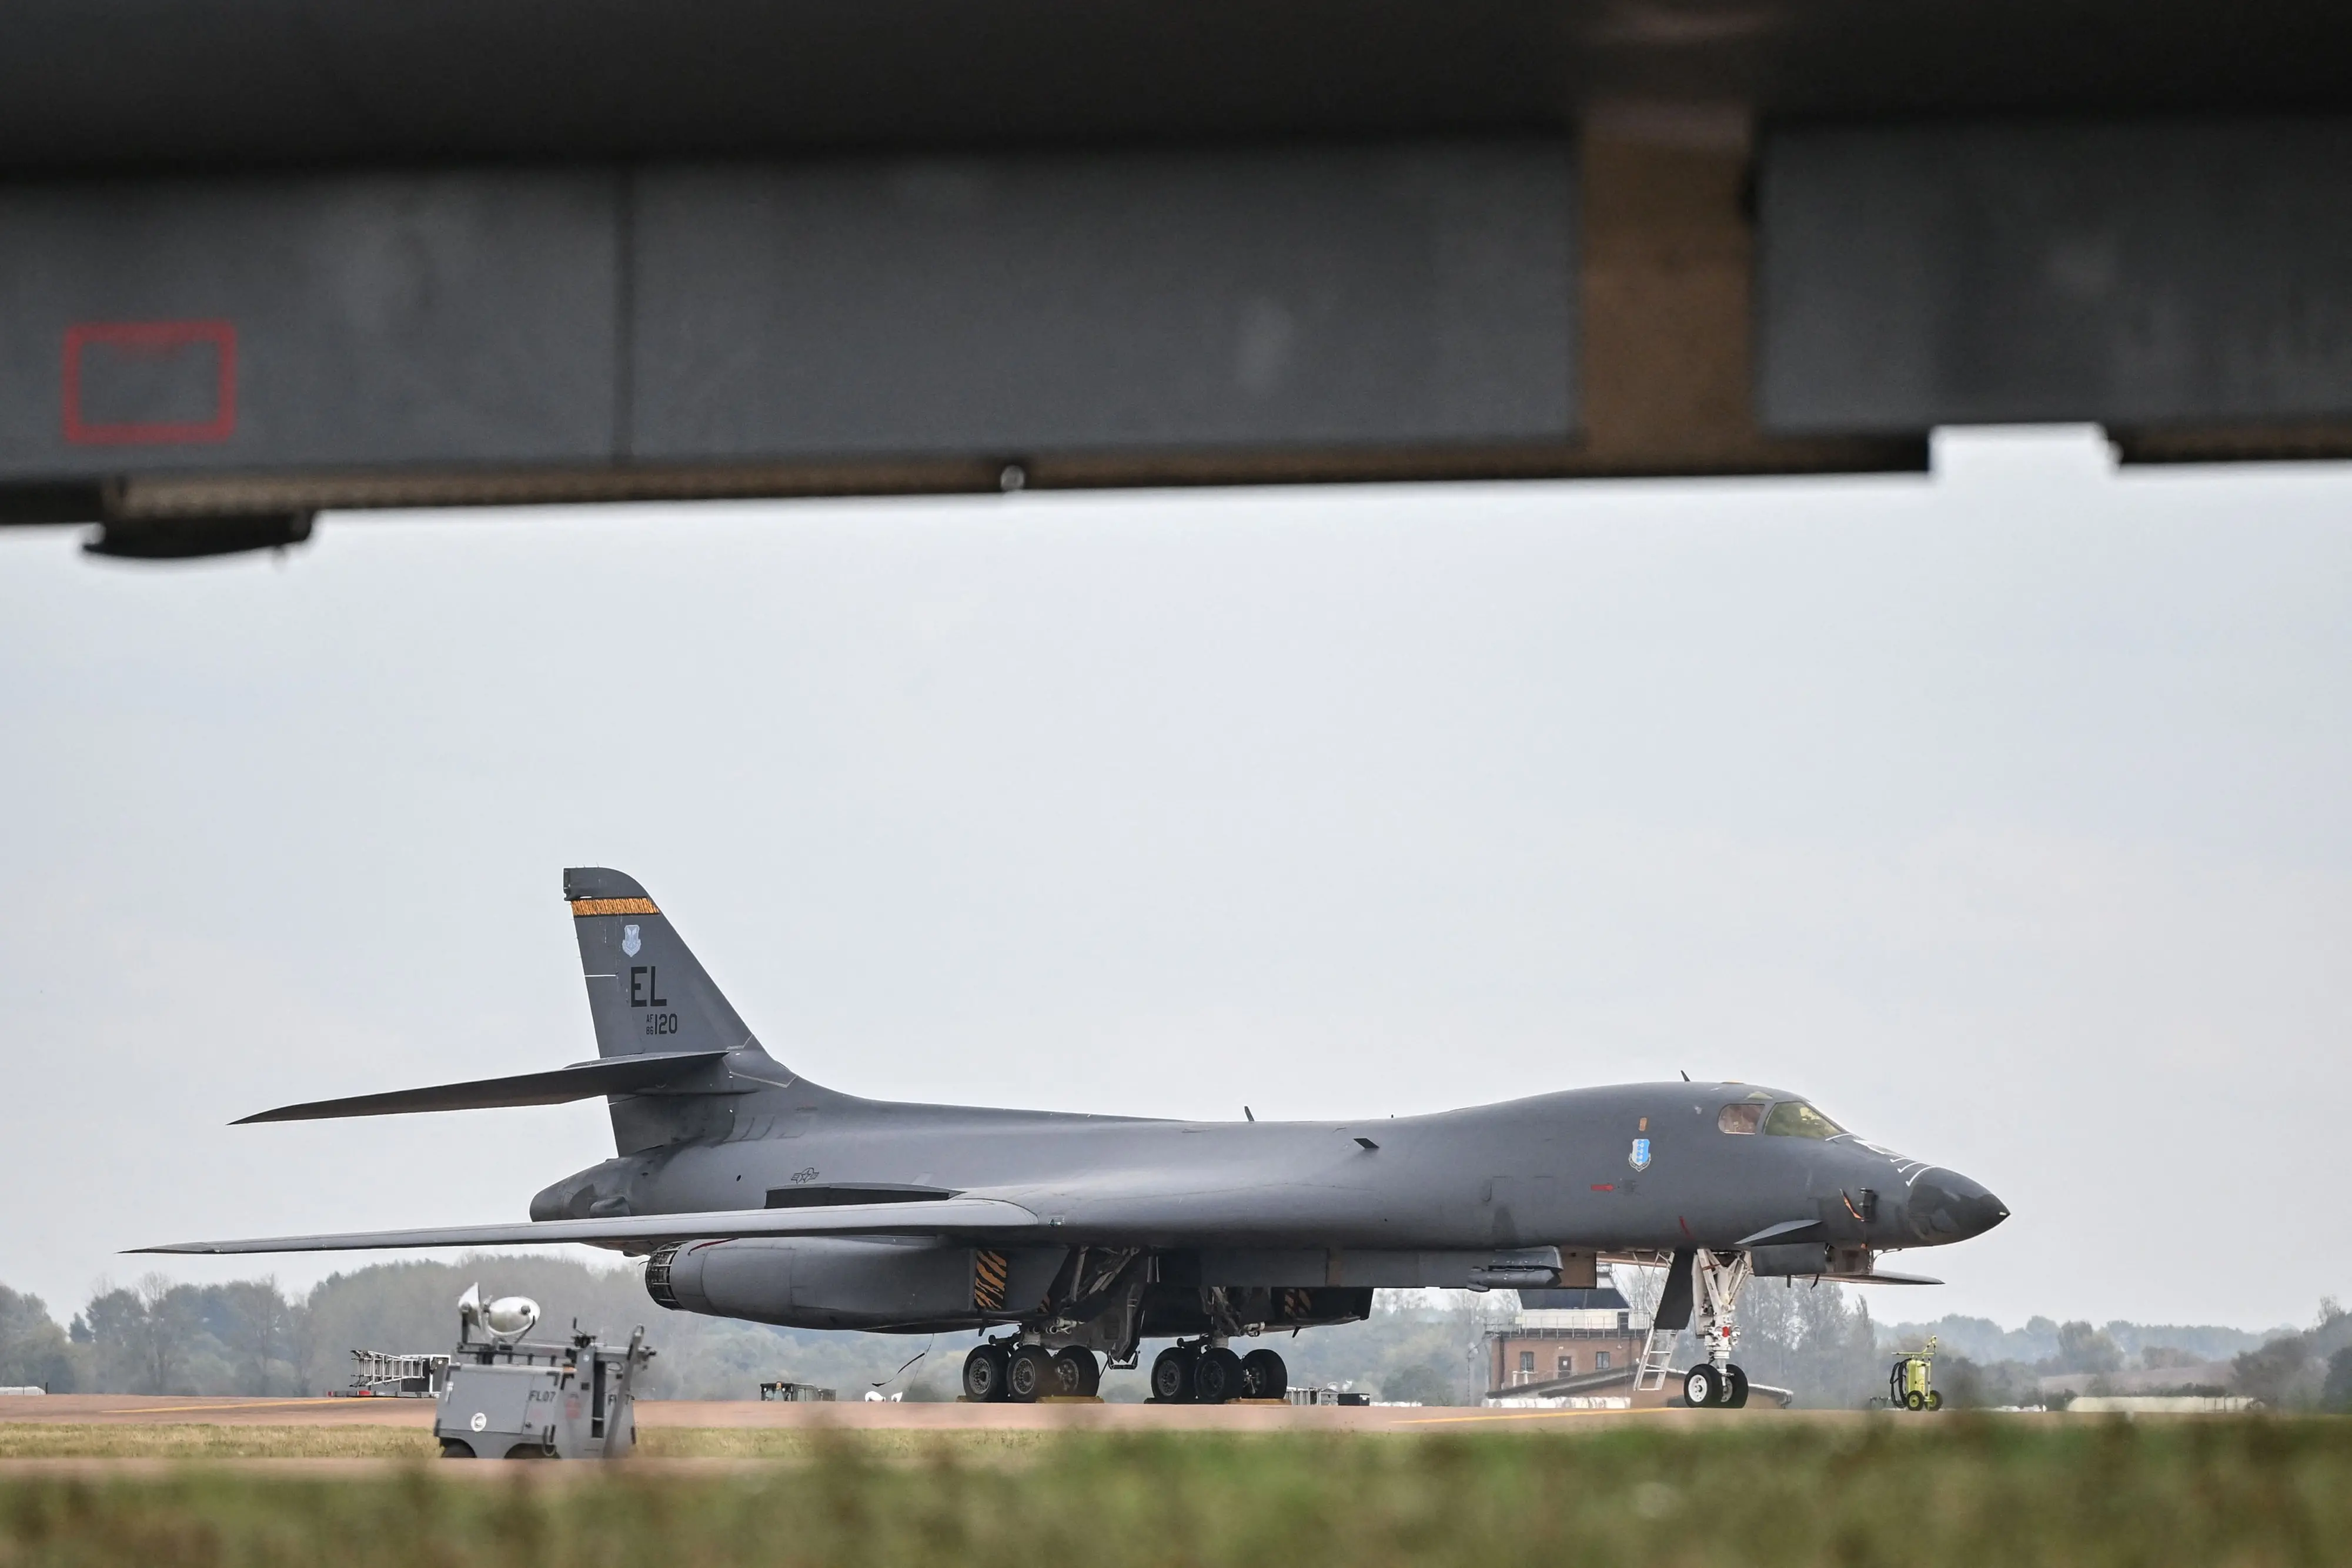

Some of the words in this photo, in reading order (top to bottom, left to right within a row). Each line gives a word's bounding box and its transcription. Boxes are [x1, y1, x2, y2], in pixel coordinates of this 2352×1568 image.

[631, 966, 667, 1007] EL
[646, 1014, 653, 1023] AF
[654, 1013, 677, 1035] 120
[646, 1027, 654, 1035] 86
[529, 1390, 556, 1403] FL07
